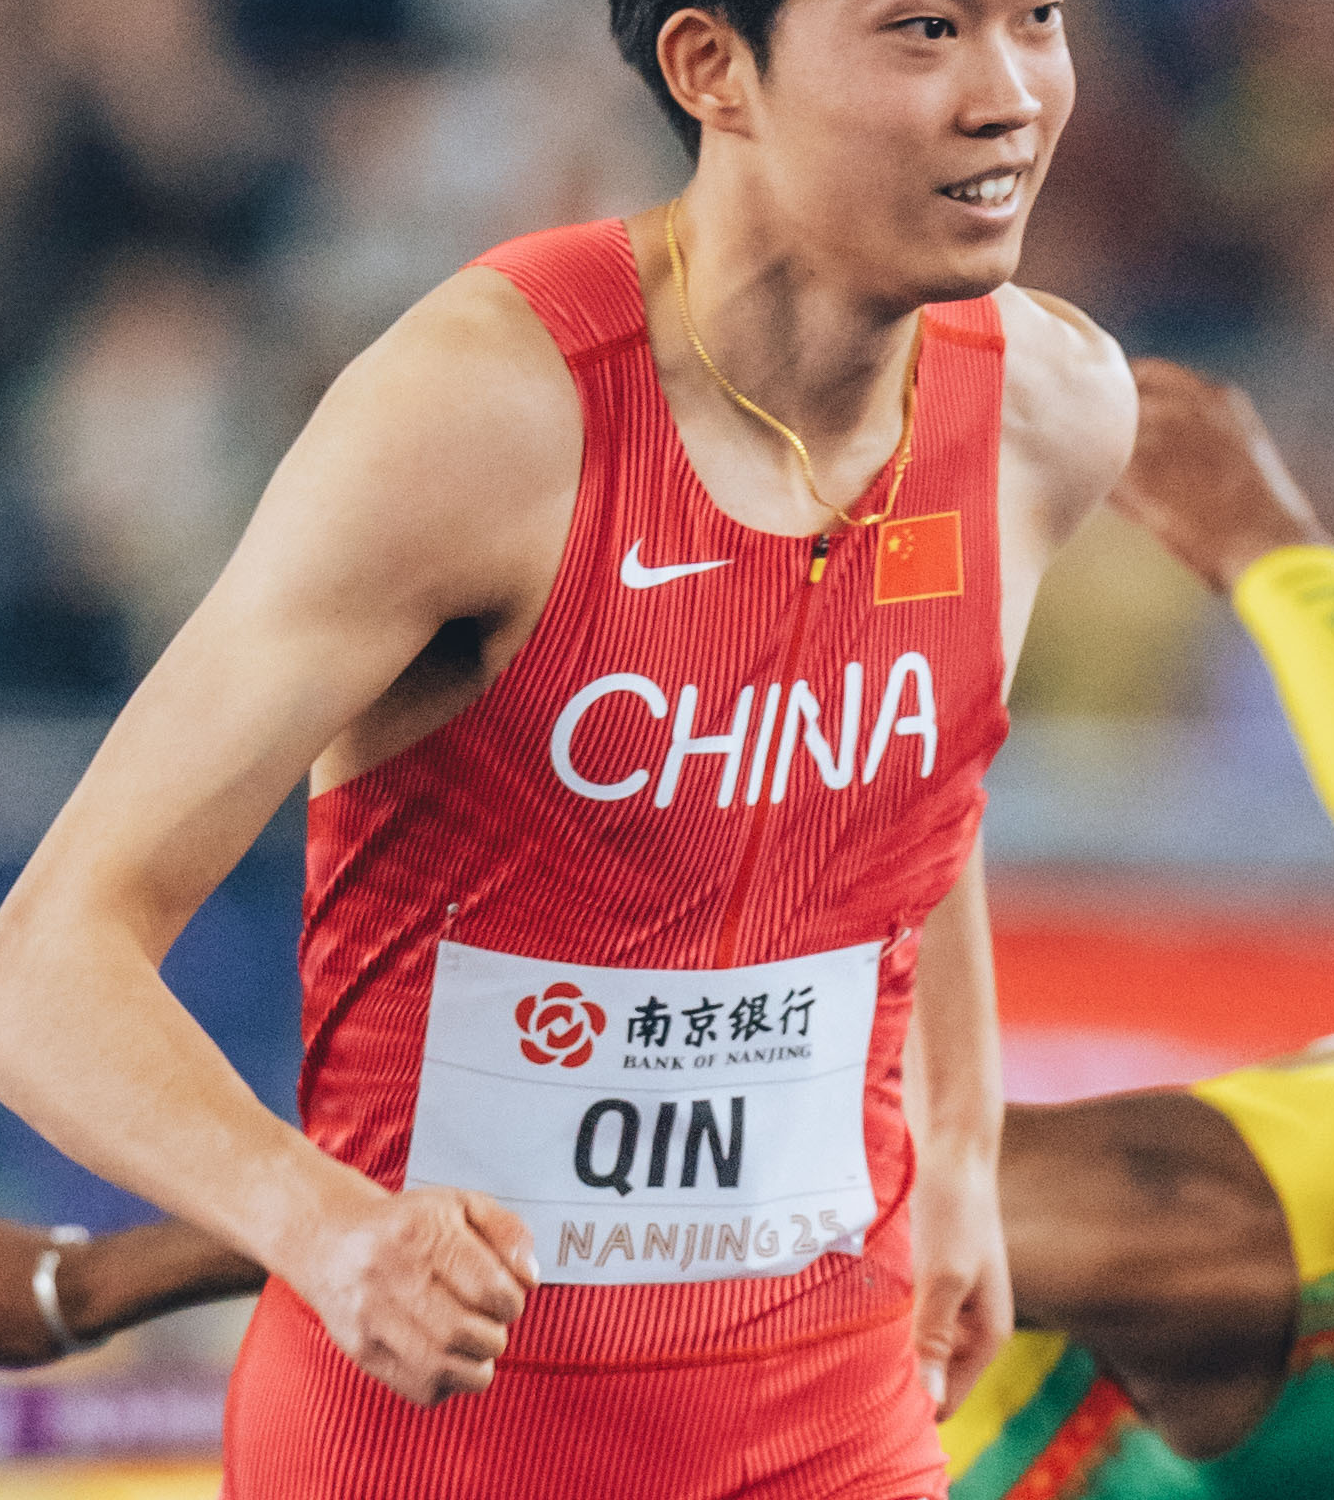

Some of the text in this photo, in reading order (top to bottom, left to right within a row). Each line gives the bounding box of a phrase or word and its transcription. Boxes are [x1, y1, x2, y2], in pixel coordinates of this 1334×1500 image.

[550, 651, 938, 809] CHINA
[627, 985, 816, 1048] 南京银行
[623, 1043, 813, 1071] BANK OF NANJING
[574, 1095, 746, 1197] QIN
[557, 1215, 781, 1273] NANJING
